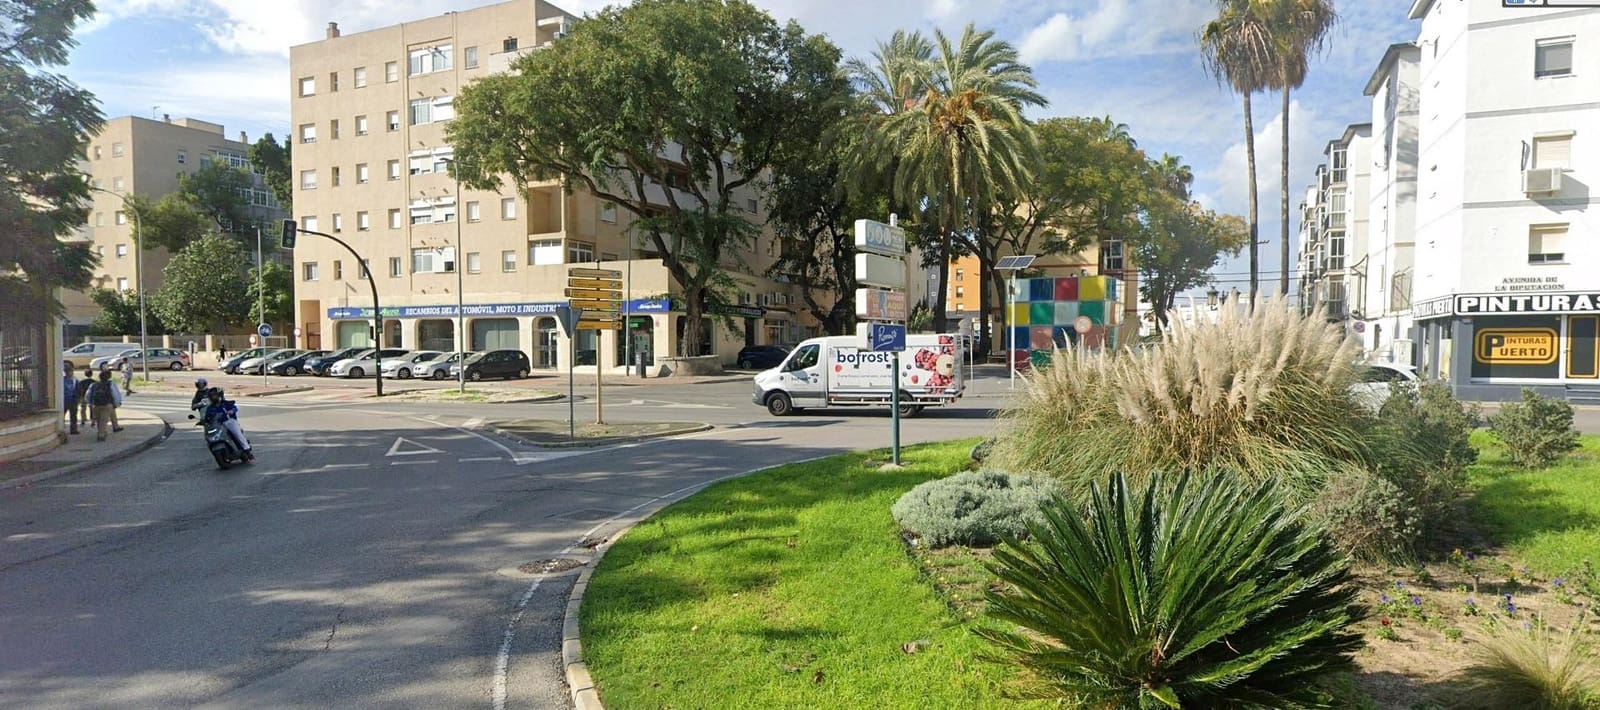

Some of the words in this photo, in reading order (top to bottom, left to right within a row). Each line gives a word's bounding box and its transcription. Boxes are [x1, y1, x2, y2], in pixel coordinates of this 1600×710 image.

[405, 307, 440, 315] RECAMBIOS
[441, 306, 452, 314] DEL
[453, 304, 494, 314] ATOMÓVIL,
[496, 305, 516, 313] MOTO
[1461, 295, 1600, 312] PINTURA
[837, 350, 889, 365] bofrost
